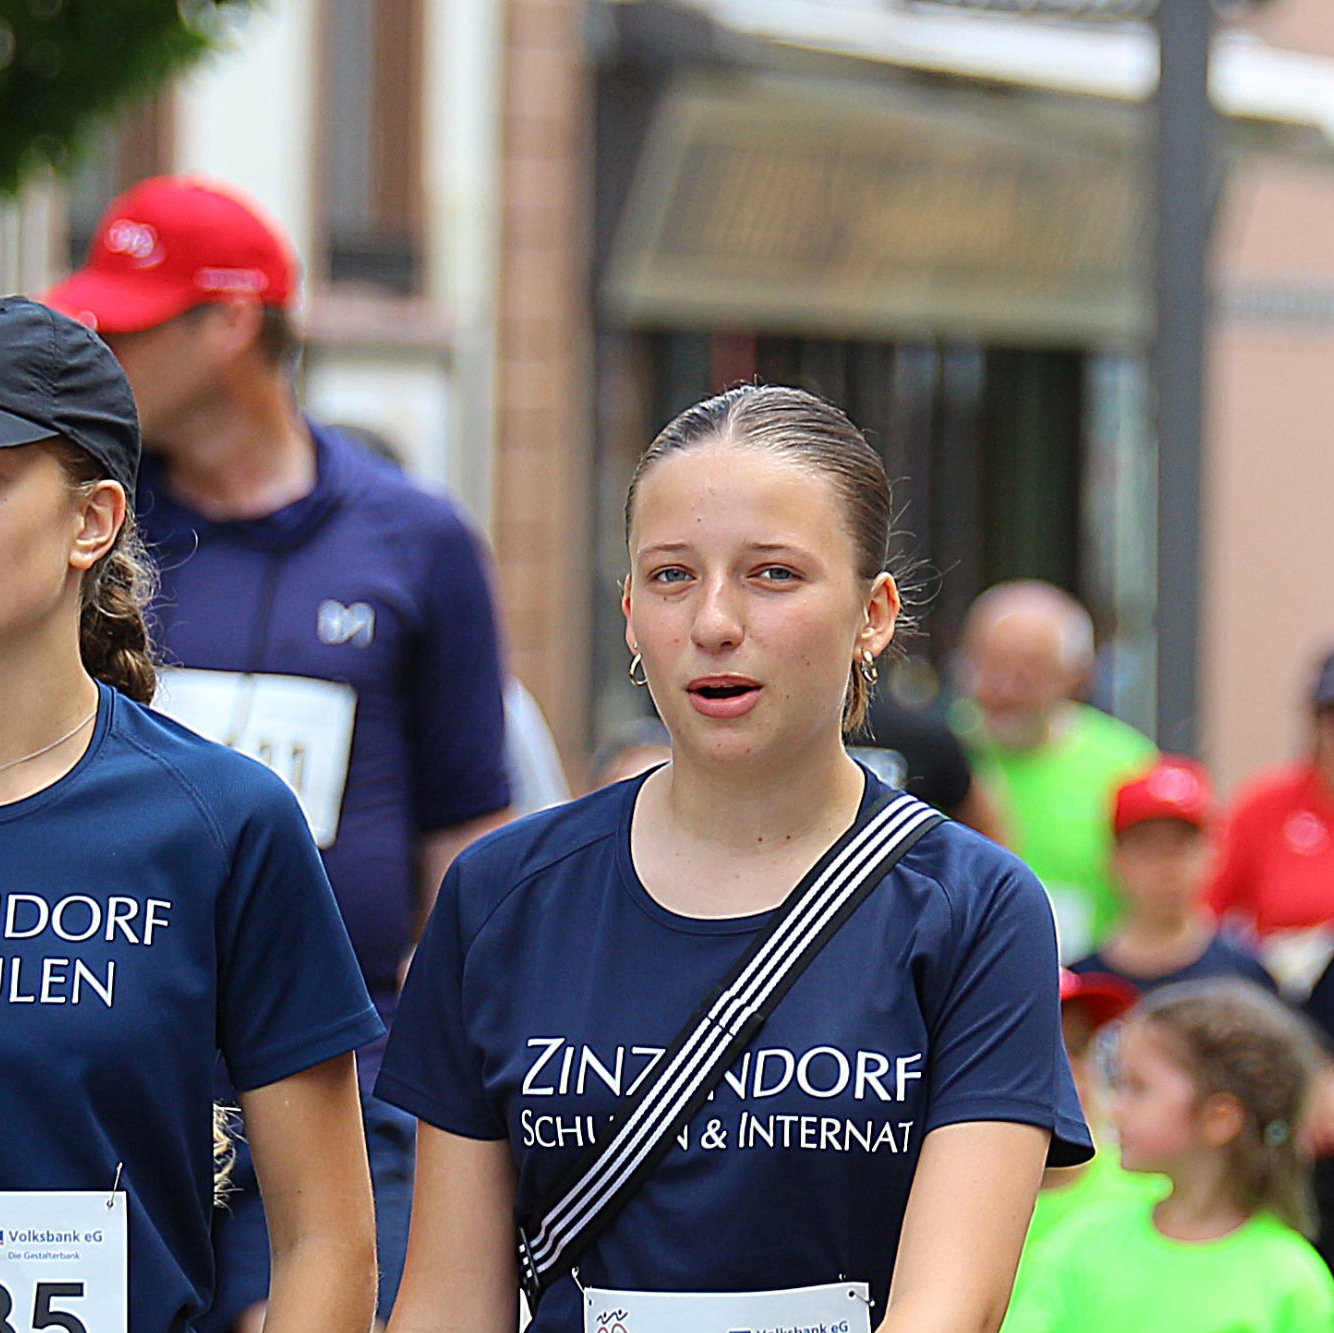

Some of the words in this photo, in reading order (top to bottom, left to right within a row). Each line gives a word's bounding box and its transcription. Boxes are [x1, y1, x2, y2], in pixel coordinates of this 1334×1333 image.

[522, 1037, 922, 1102] ZINZNDORF
[701, 1118, 727, 1149] &
[738, 1112, 914, 1153] INTERNAT
[9, 1229, 80, 1243] Volksbank
[85, 1230, 103, 1243] eG
[24, 1250, 80, 1260] Gestalterbank
